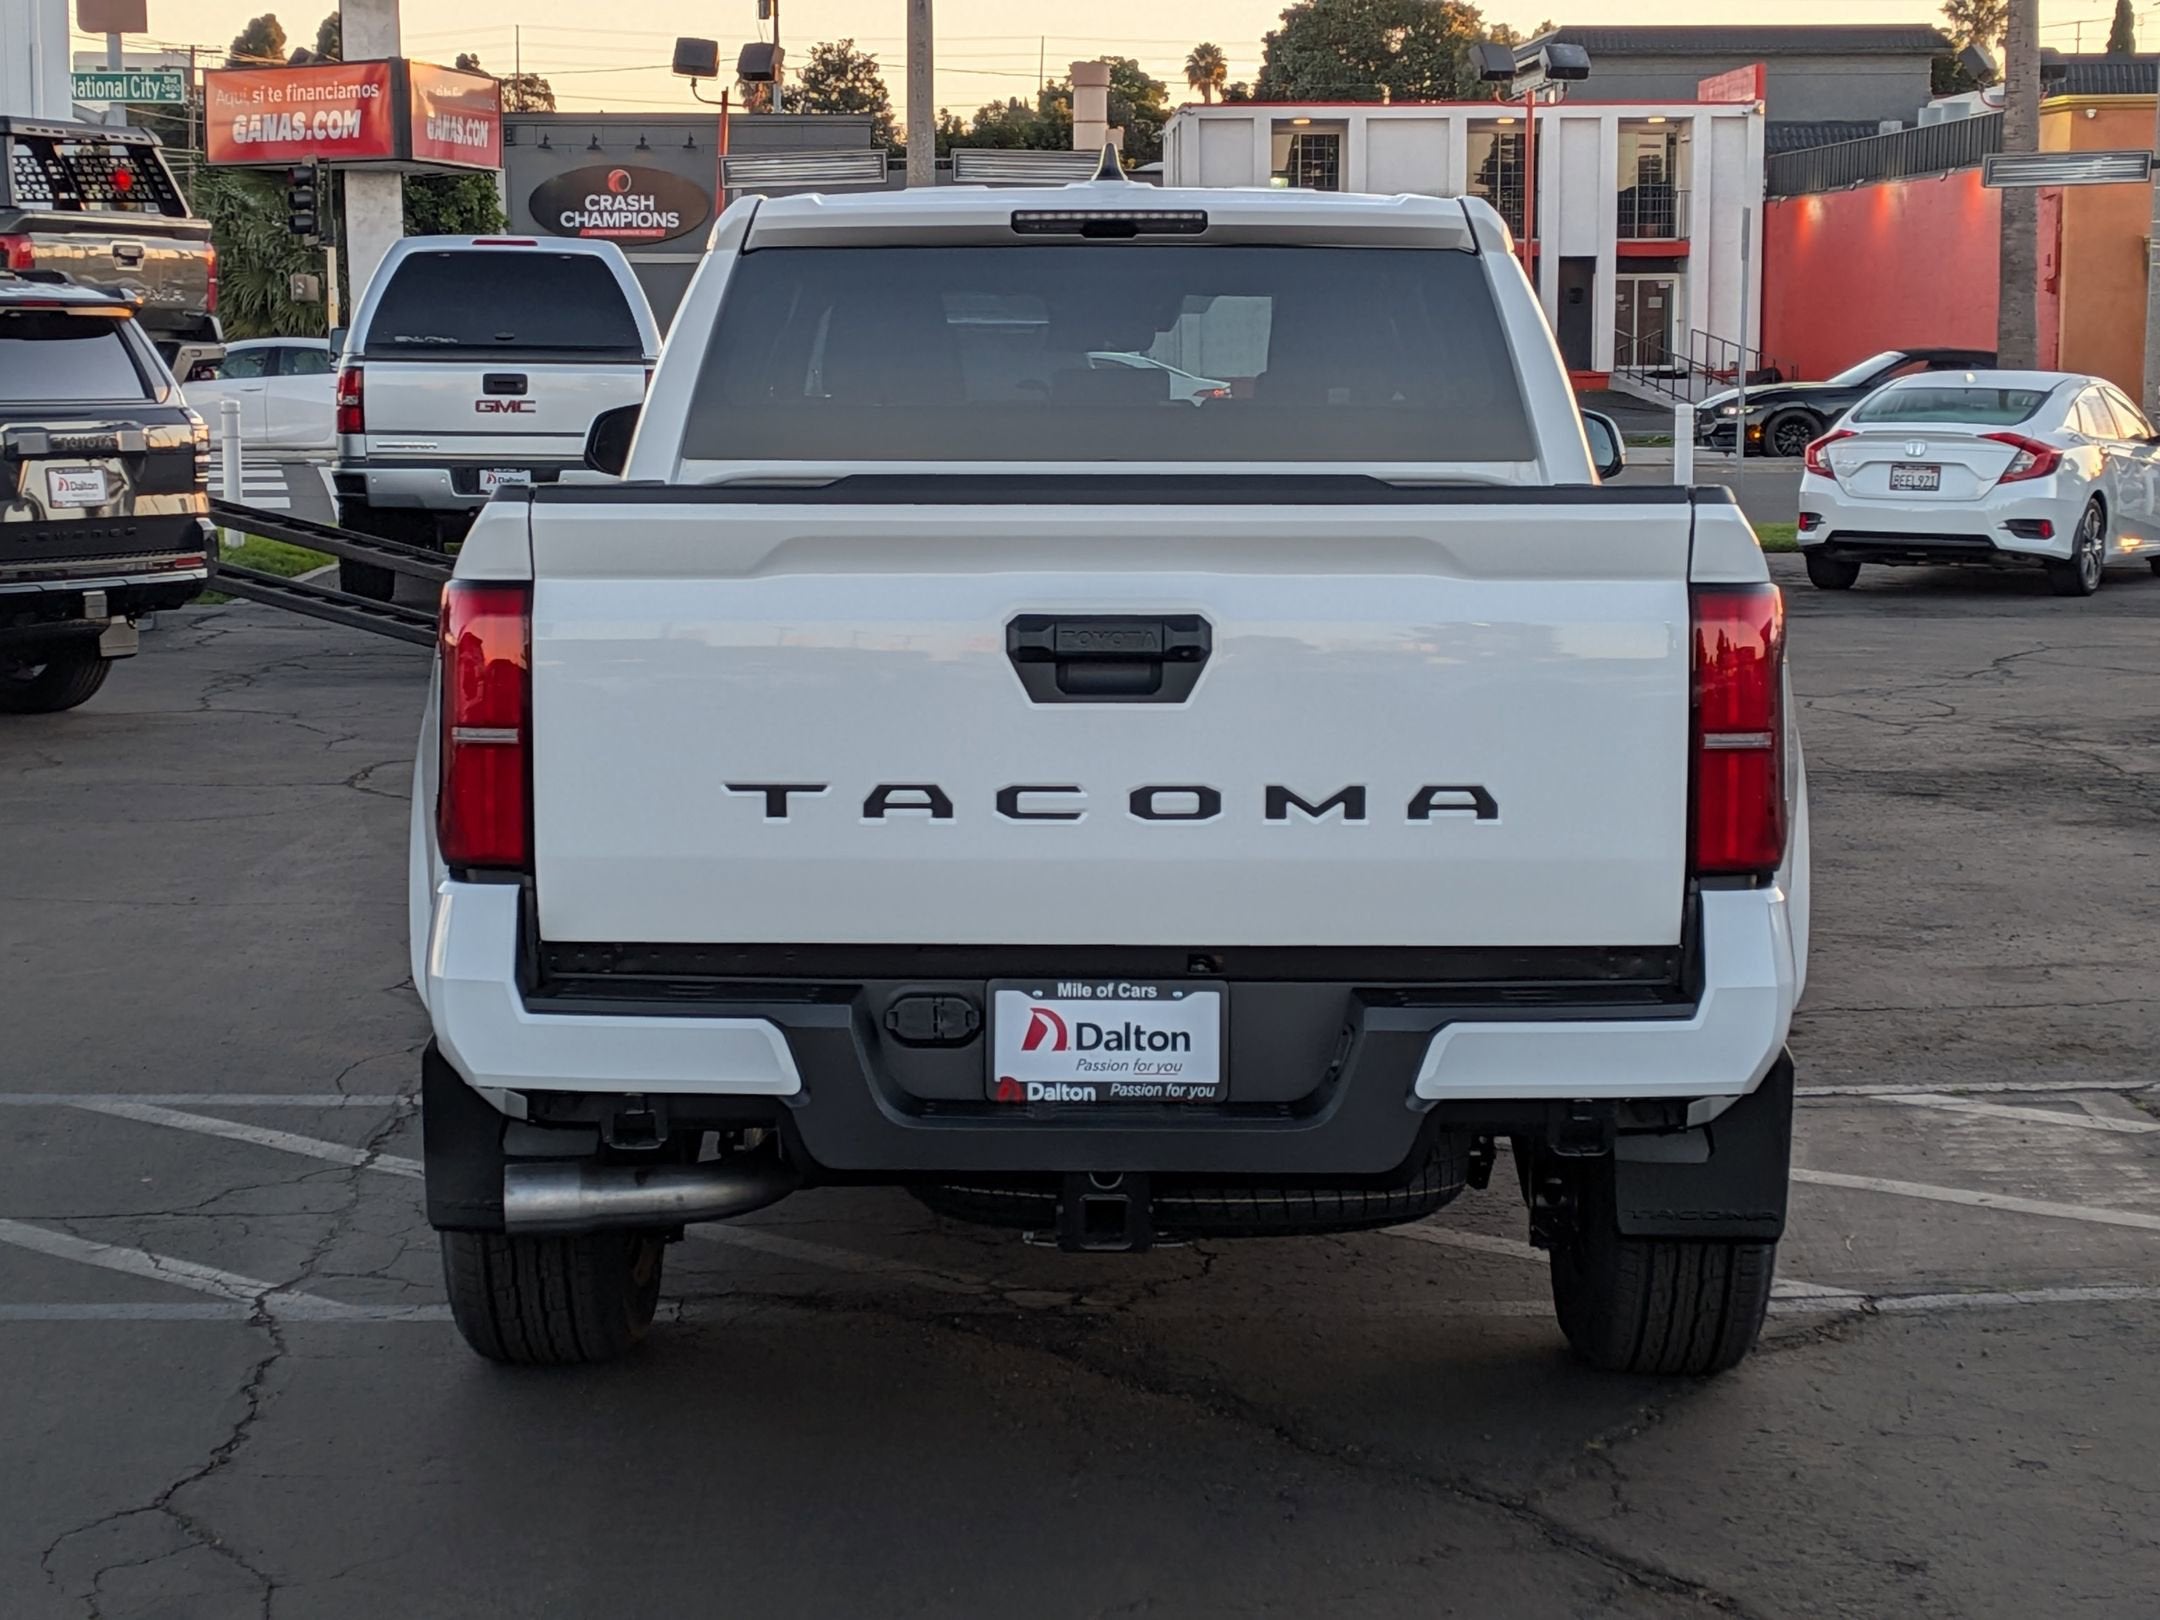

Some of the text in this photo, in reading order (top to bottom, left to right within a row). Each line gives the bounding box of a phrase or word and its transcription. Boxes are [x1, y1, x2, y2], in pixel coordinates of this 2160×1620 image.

[130, 75, 160, 100] City
[268, 86, 283, 103] te
[286, 81, 380, 102] financiamos
[232, 109, 362, 144] GANAS.COM
[426, 114, 489, 148] GANAS.COM
[584, 194, 655, 211] CRASH
[559, 211, 680, 228] CHAMPIONS
[475, 400, 536, 413] GMC
[70, 480, 99, 491] Dalton
[1060, 630, 1158, 649] TOYOTA
[722, 783, 1500, 823] TACOMA
[1057, 982, 1158, 998] Mile of Cars
[1076, 1022, 1191, 1052] Dalton
[1075, 1058, 1183, 1074] Passion for you
[1027, 1082, 1097, 1101] Dalton
[1110, 1083, 1216, 1099] Passion for you
